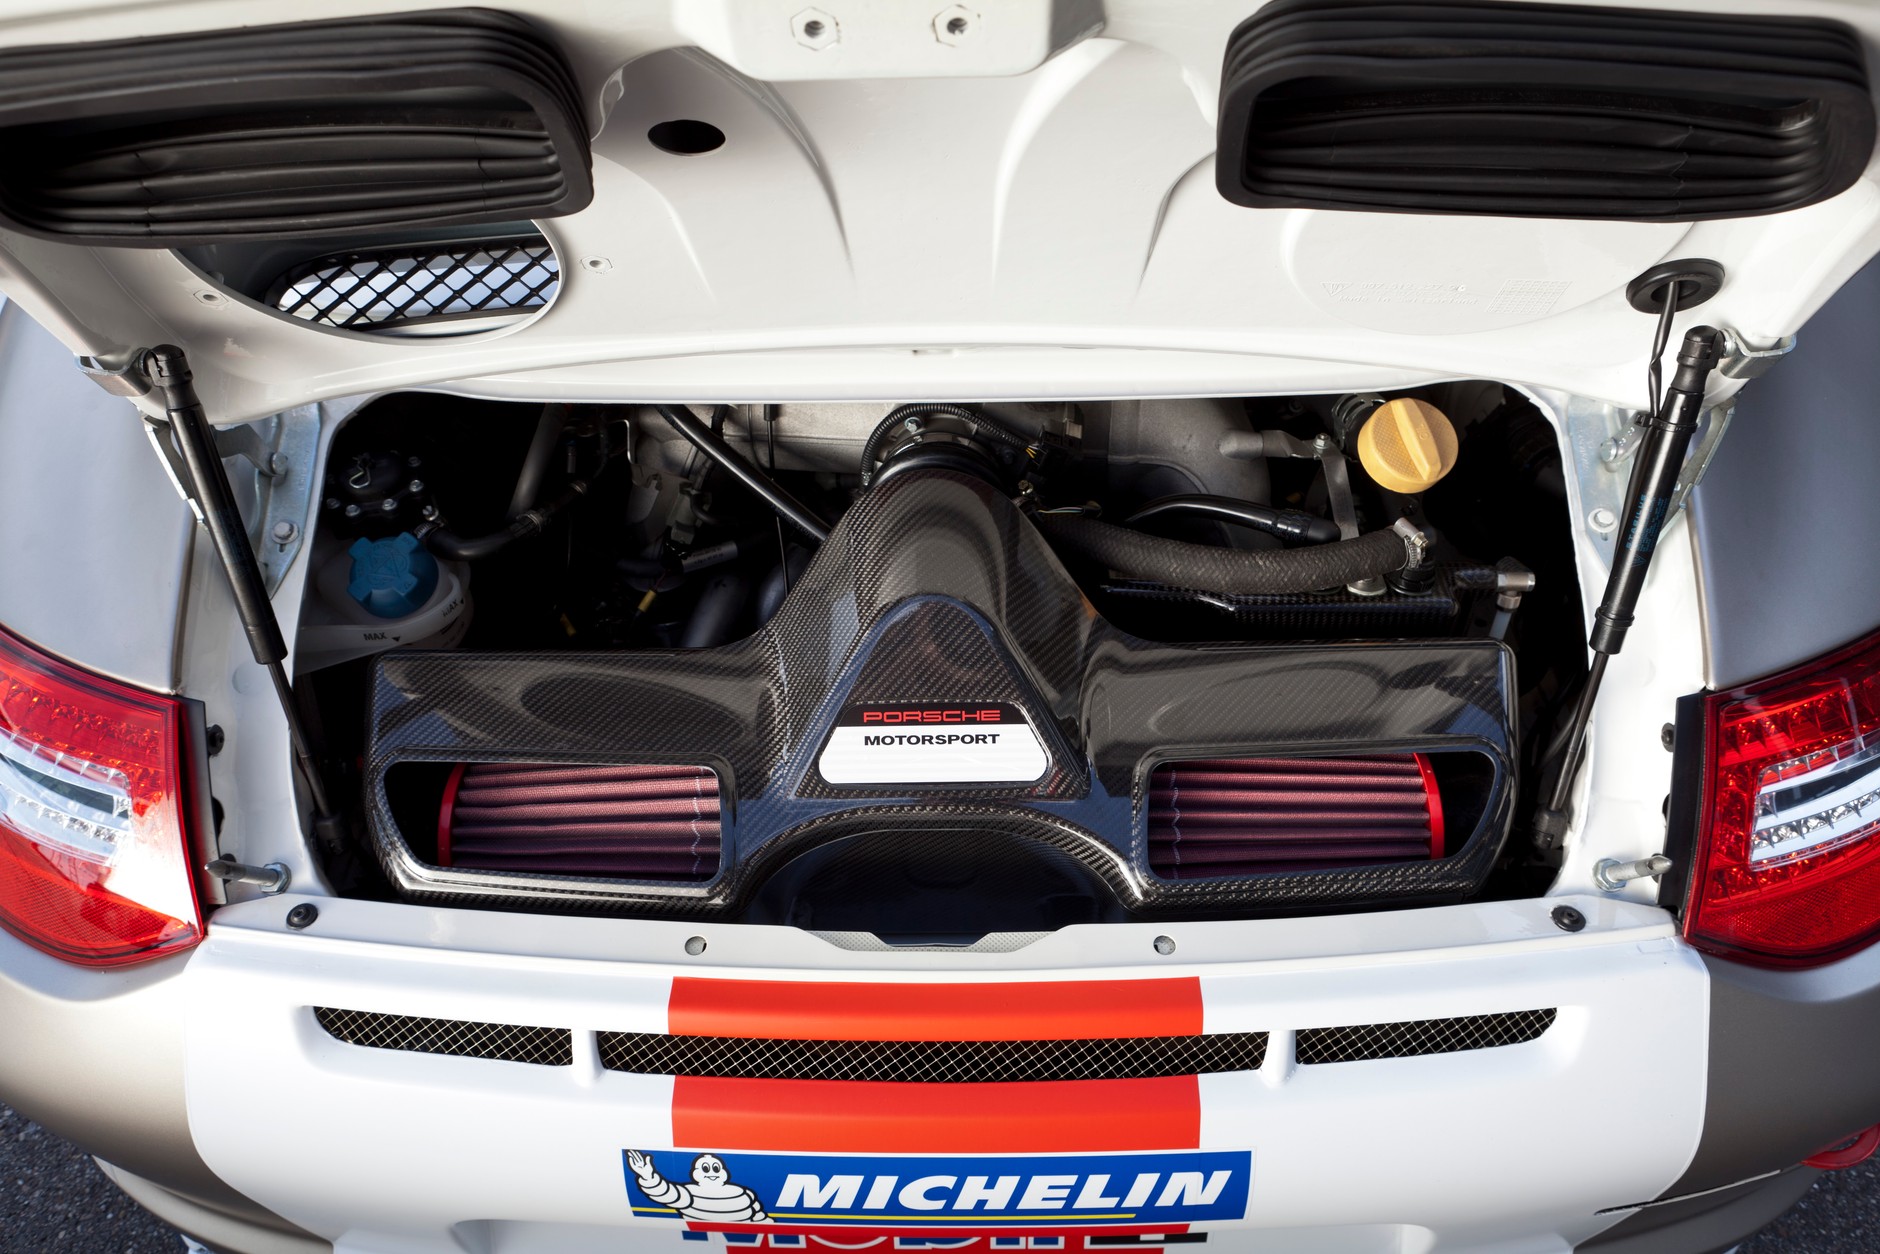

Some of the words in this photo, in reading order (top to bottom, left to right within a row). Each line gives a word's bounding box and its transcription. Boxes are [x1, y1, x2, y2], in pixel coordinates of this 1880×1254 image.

[363, 631, 388, 642] MAX
[863, 709, 1001, 723] PORSCHE
[863, 733, 1000, 747] MOTORSPORT
[774, 1169, 1233, 1211] MICHELIN
